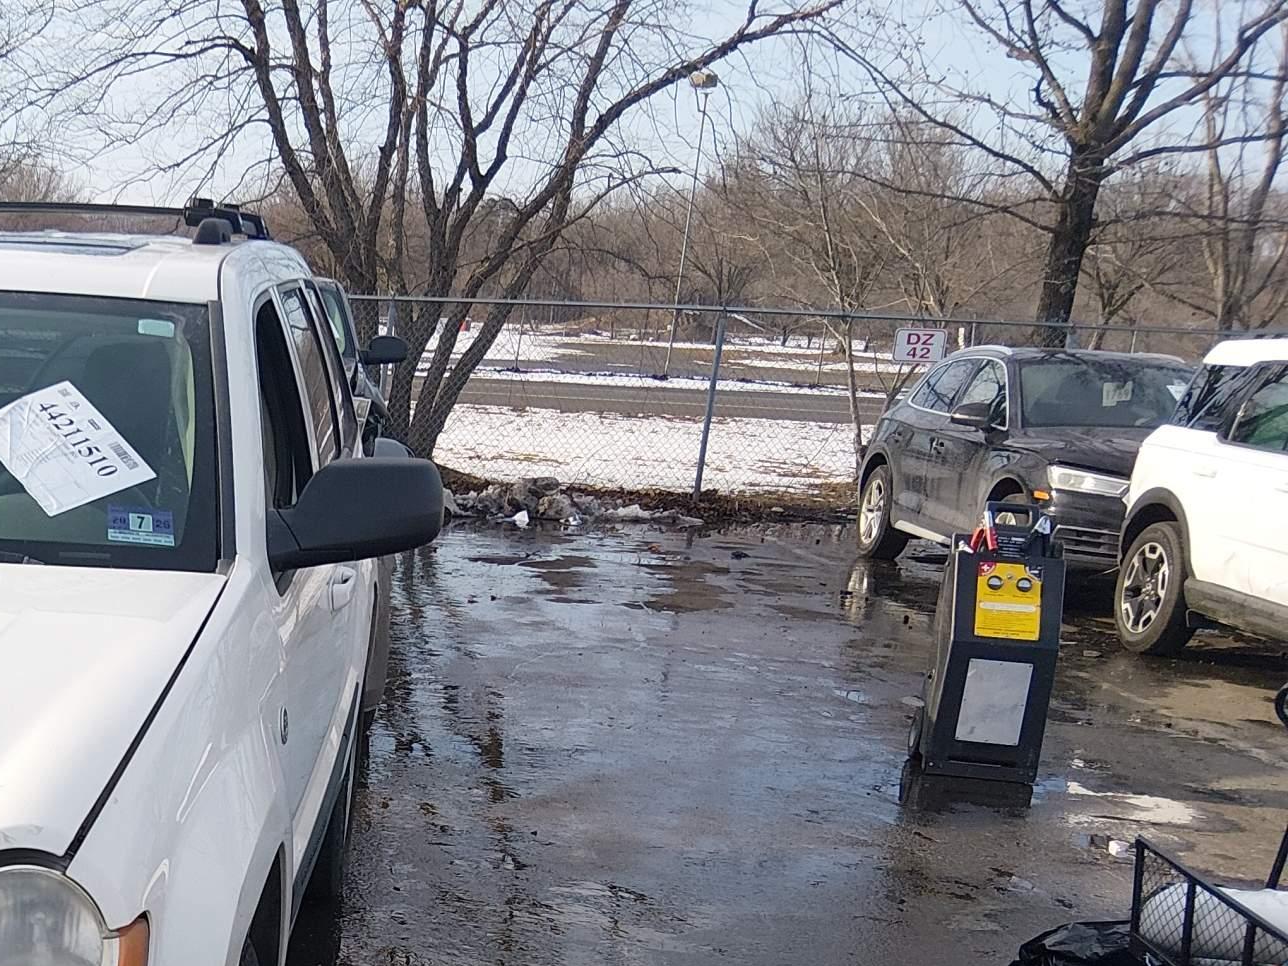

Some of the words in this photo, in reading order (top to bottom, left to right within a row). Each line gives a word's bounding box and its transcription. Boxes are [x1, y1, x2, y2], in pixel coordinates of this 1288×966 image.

[906, 332, 935, 346] DZ
[906, 346, 931, 359] 42
[39, 402, 118, 477] 44211510
[136, 515, 146, 530] 7
